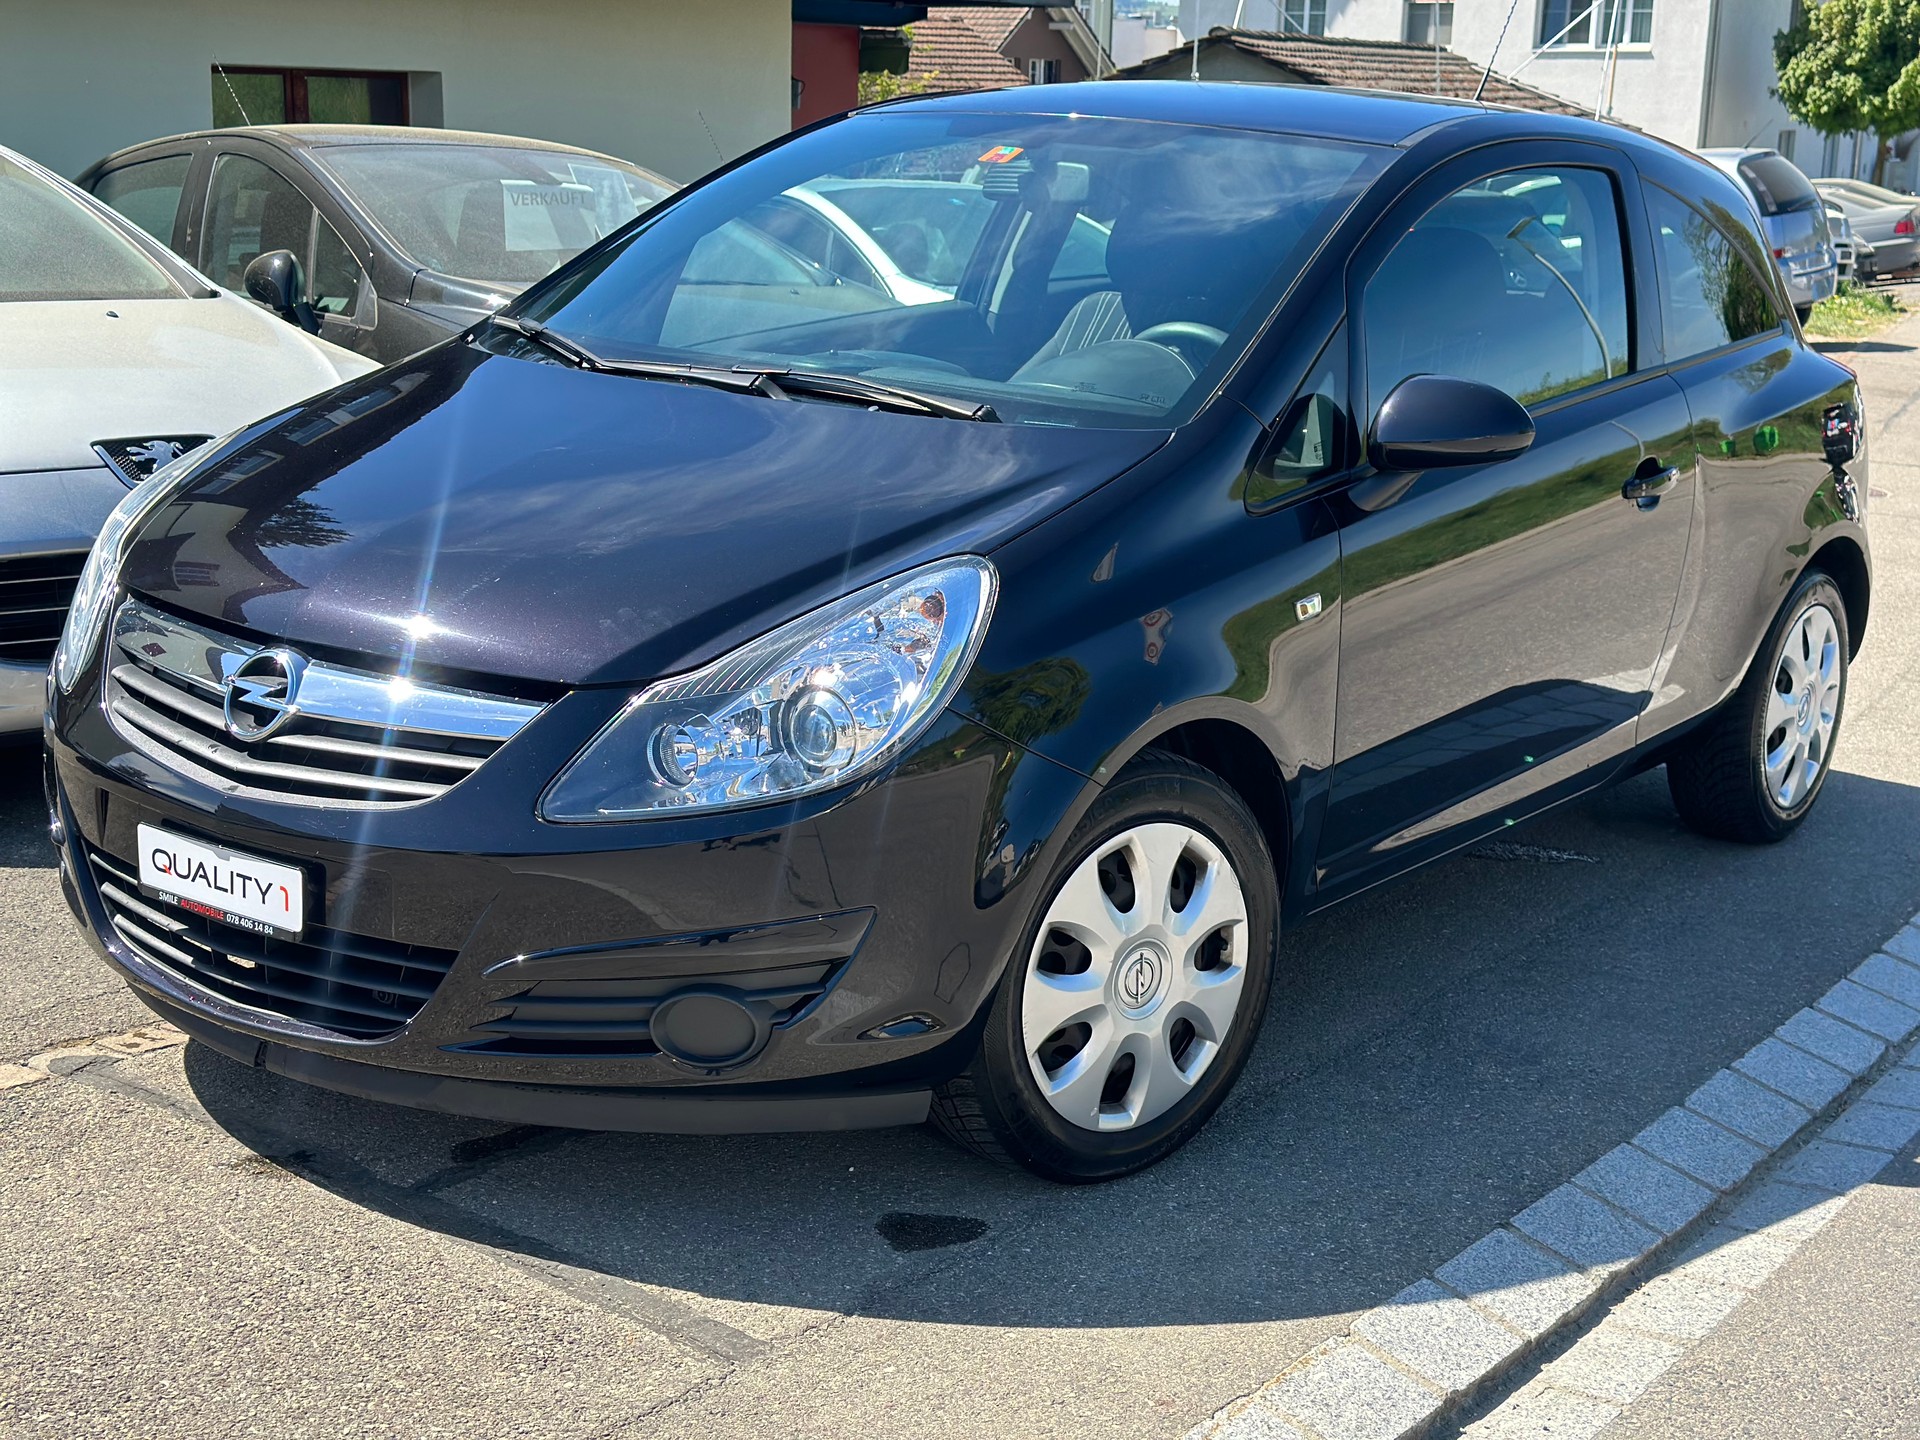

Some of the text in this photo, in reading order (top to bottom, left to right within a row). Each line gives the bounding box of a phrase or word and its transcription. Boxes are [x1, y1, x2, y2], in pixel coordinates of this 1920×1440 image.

[510, 191, 586, 206] VERKAUFT
[152, 848, 289, 912] QUALITY 1
[158, 891, 273, 935] SMILE AUTOMOBILE 078 406 14 84
